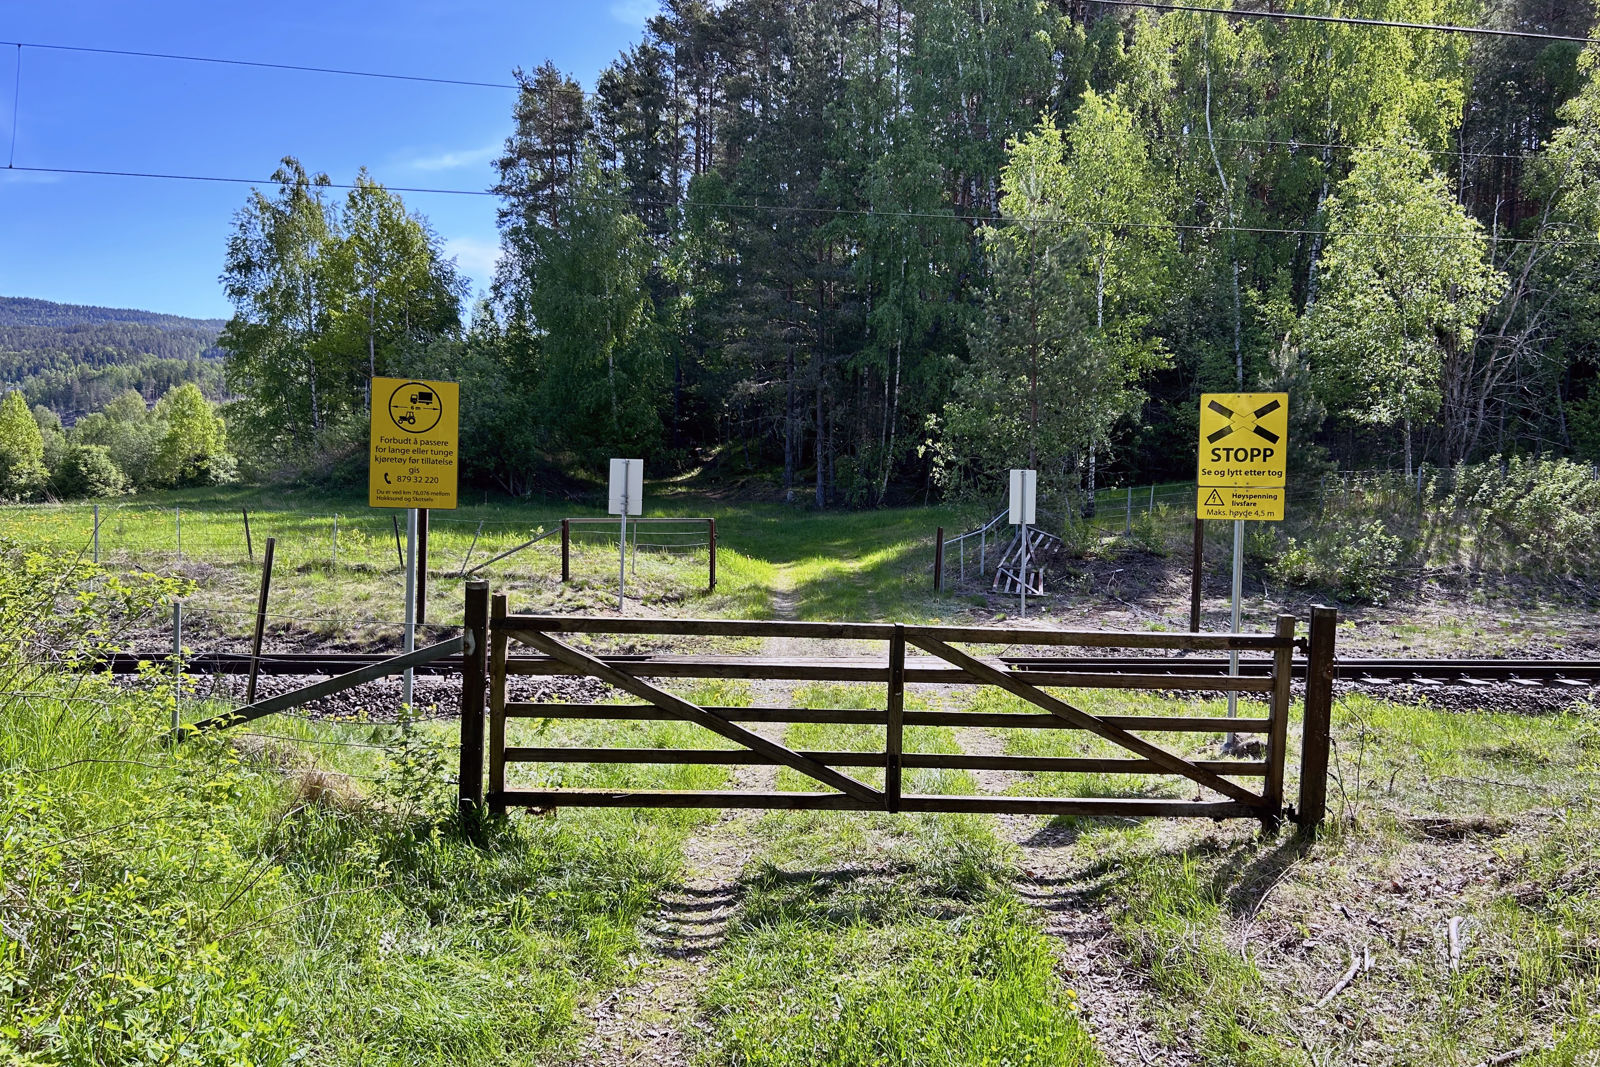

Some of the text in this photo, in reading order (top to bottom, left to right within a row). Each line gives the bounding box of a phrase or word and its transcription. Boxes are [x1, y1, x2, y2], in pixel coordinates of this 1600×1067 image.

[380, 436, 411, 444] Forbudt
[376, 445, 386, 453] for
[388, 446, 410, 455] lange
[431, 449, 453, 457] tunge
[1211, 448, 1274, 462] STOPP
[375, 455, 407, 464] kjøretøy
[1228, 469, 1242, 477] lytt
